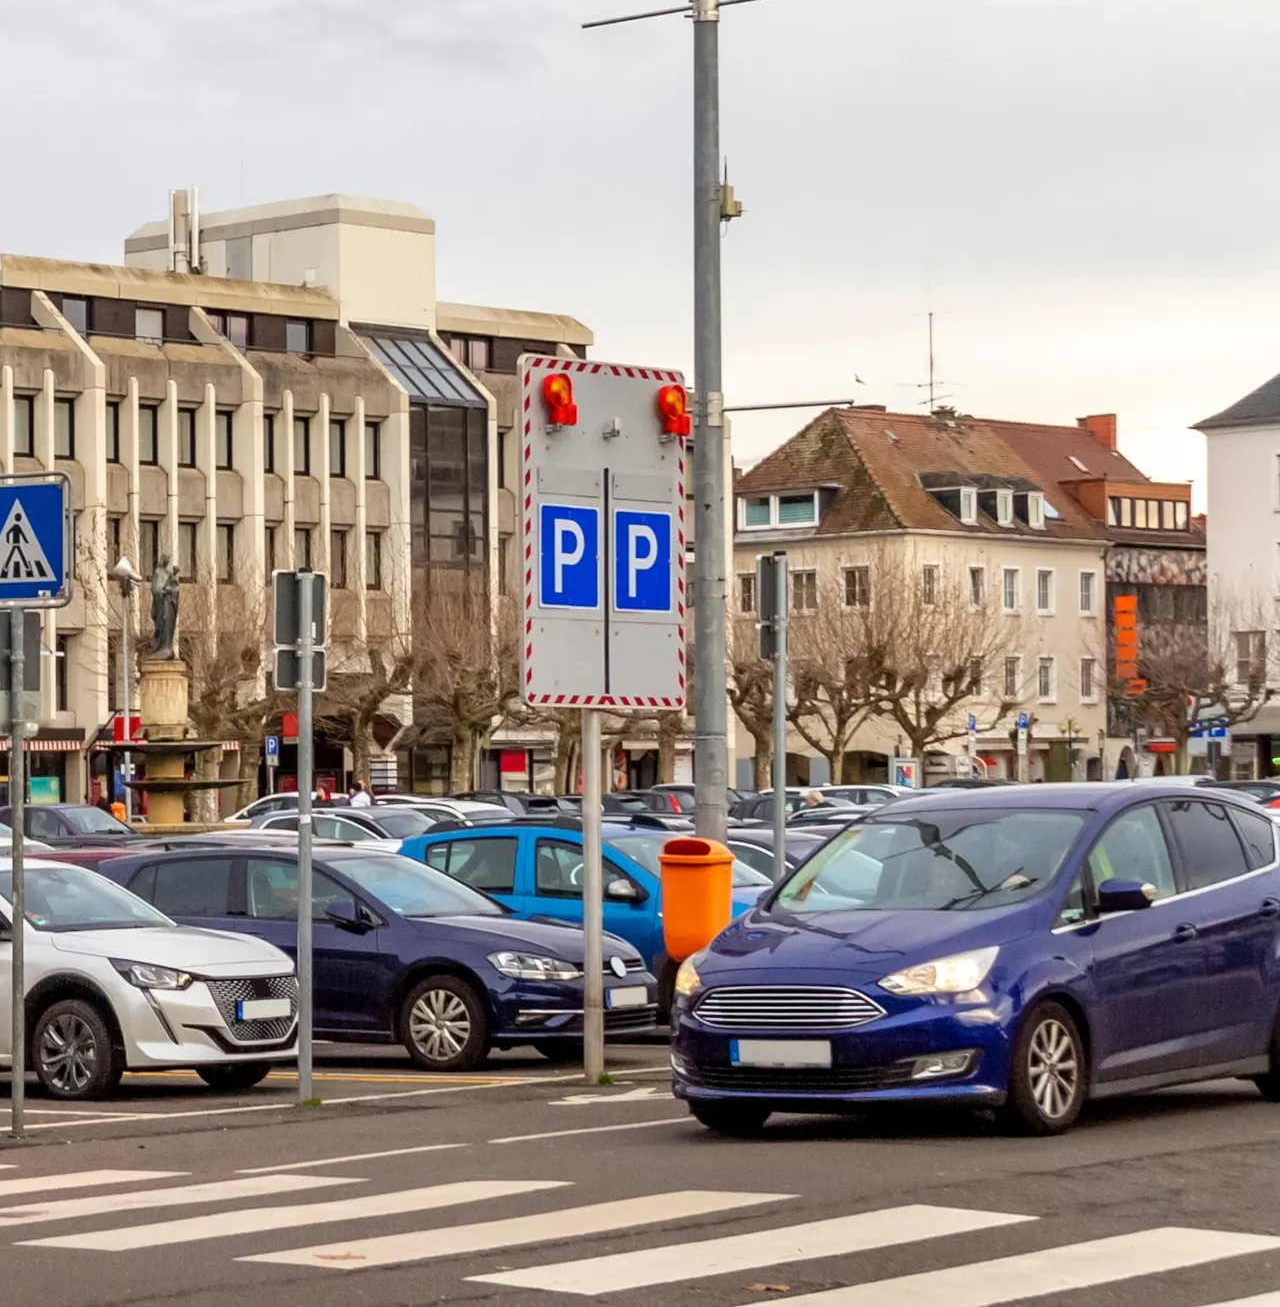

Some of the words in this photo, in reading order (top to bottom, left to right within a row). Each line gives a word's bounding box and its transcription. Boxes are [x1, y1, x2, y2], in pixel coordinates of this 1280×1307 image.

[554, 519, 585, 593] P
[628, 524, 658, 598] P
[268, 738, 276, 753] P
